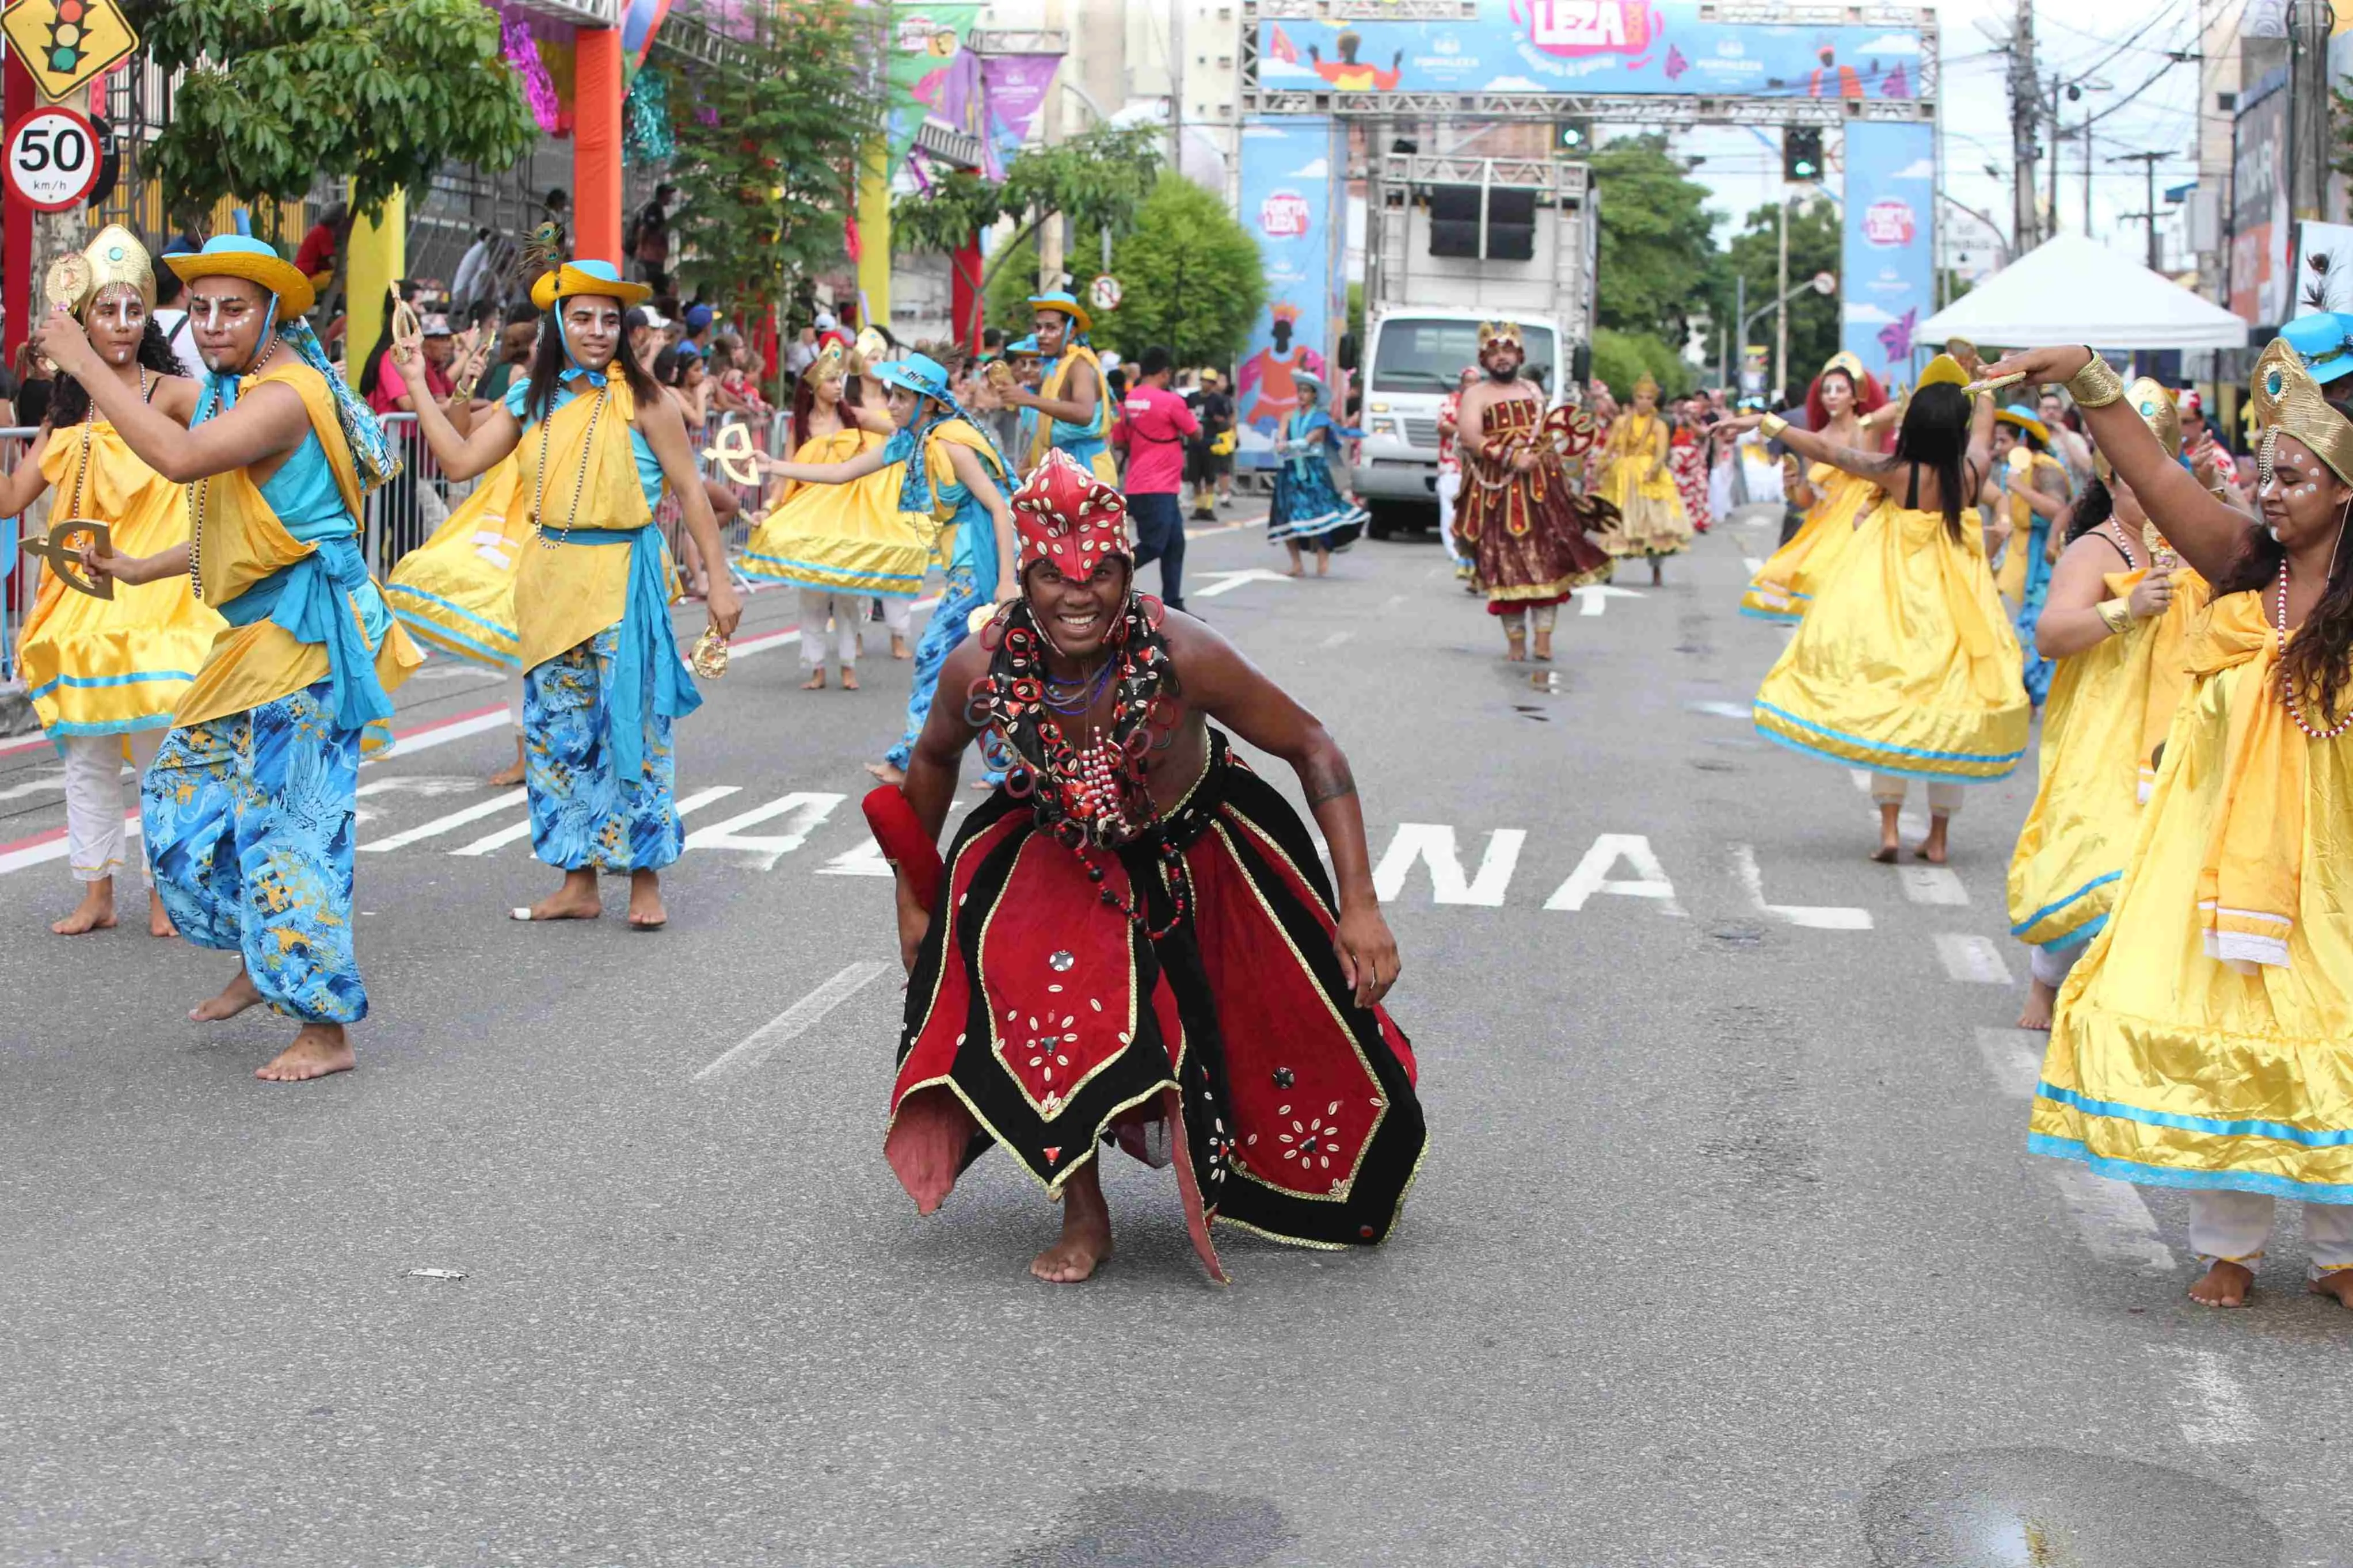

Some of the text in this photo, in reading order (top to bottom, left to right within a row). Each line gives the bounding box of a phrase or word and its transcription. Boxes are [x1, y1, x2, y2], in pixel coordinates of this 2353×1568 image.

[1533, 0, 1627, 45] LEZA
[19, 129, 85, 171] 50
[33, 181, 66, 190] km/h
